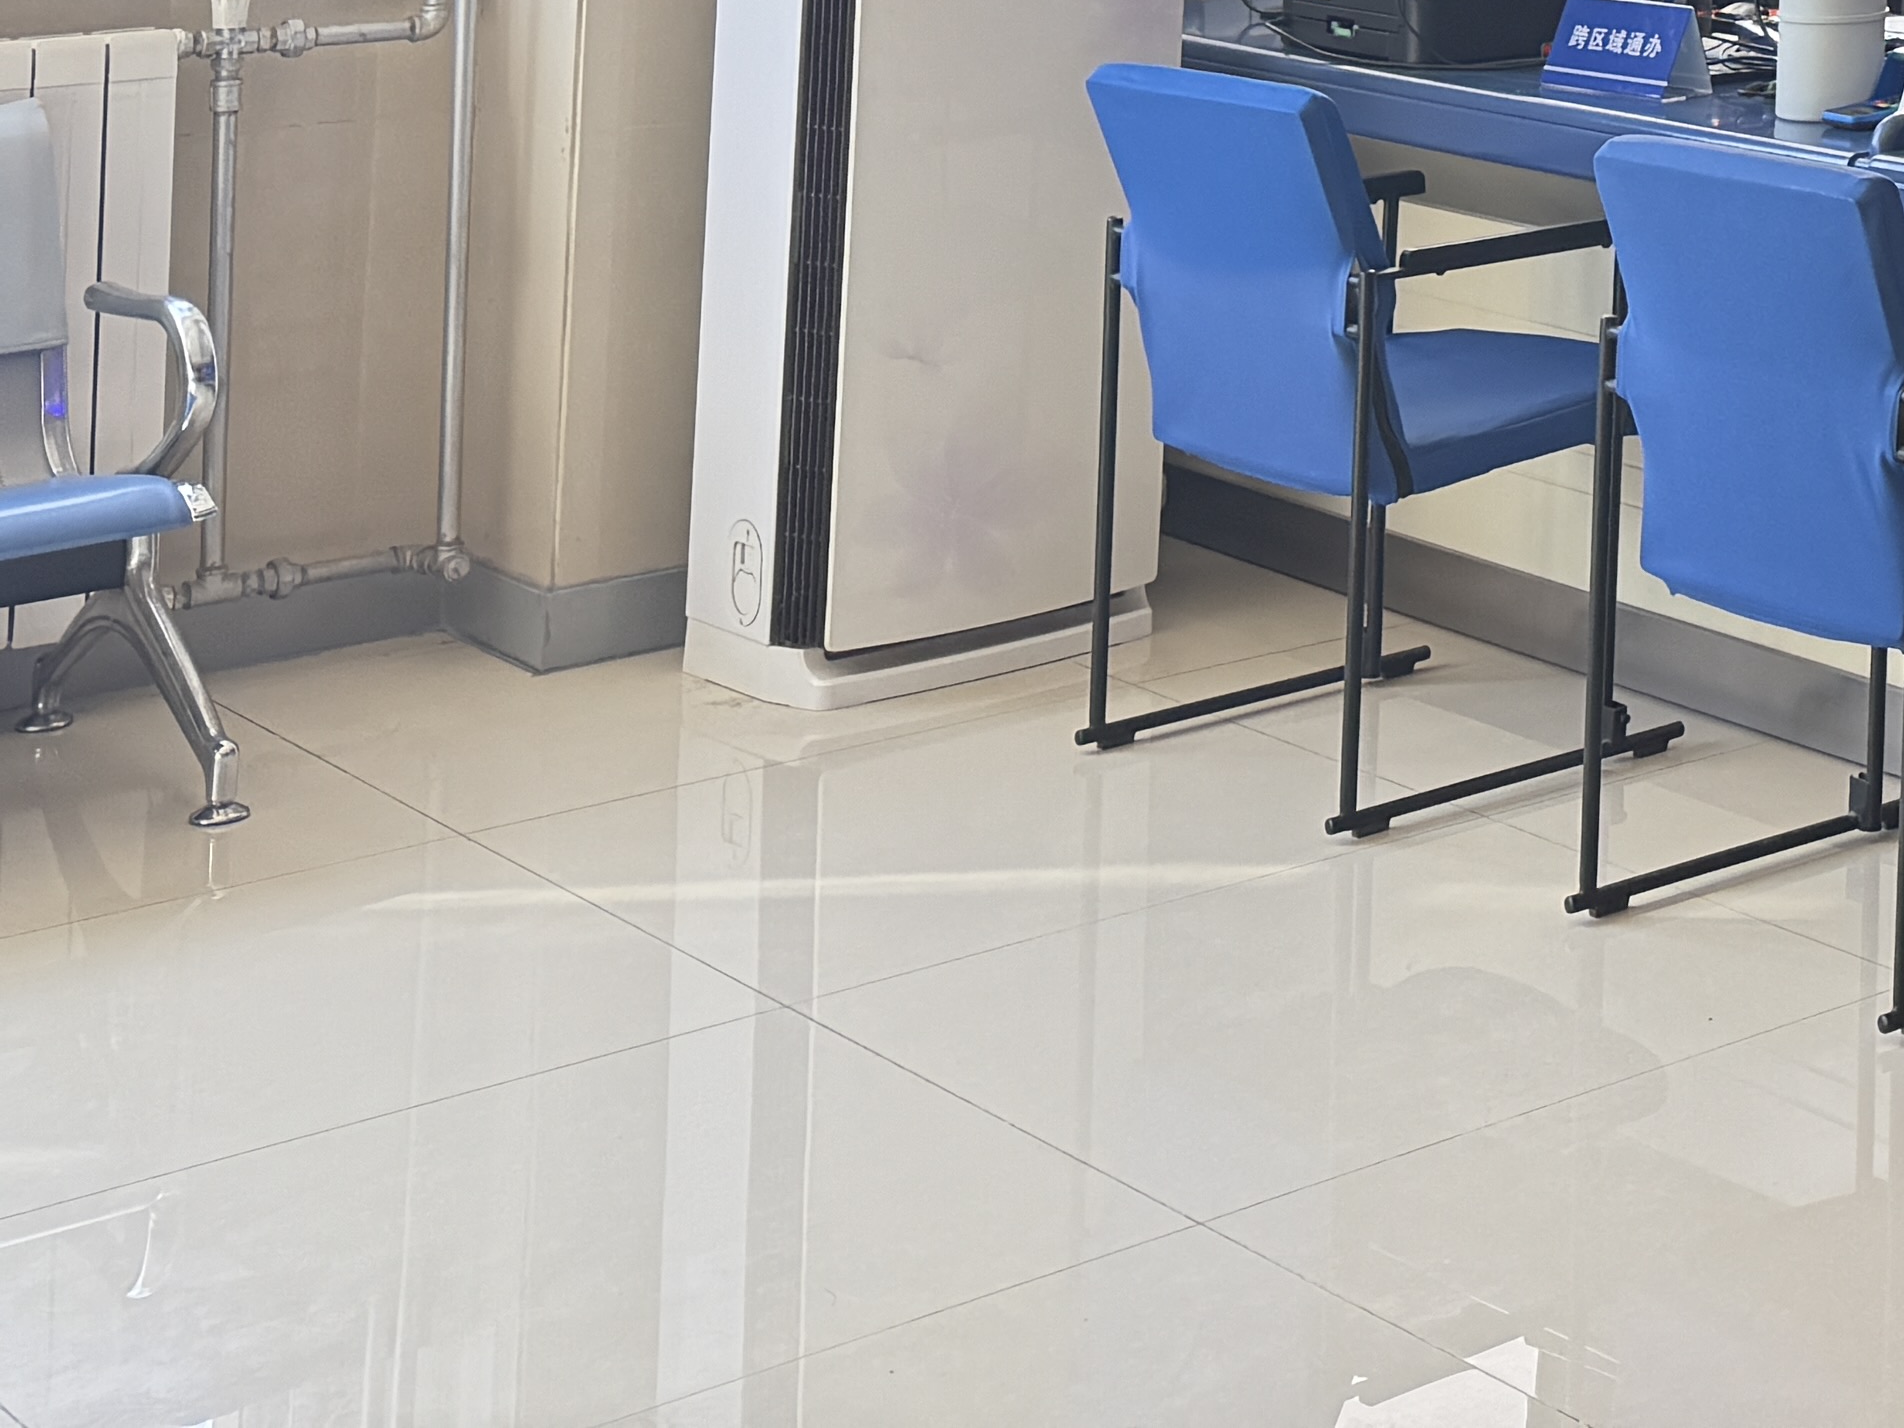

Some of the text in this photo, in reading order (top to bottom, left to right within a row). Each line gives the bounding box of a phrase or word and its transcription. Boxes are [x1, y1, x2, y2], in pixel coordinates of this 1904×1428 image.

[1567, 24, 1663, 59] 跨区域通办
